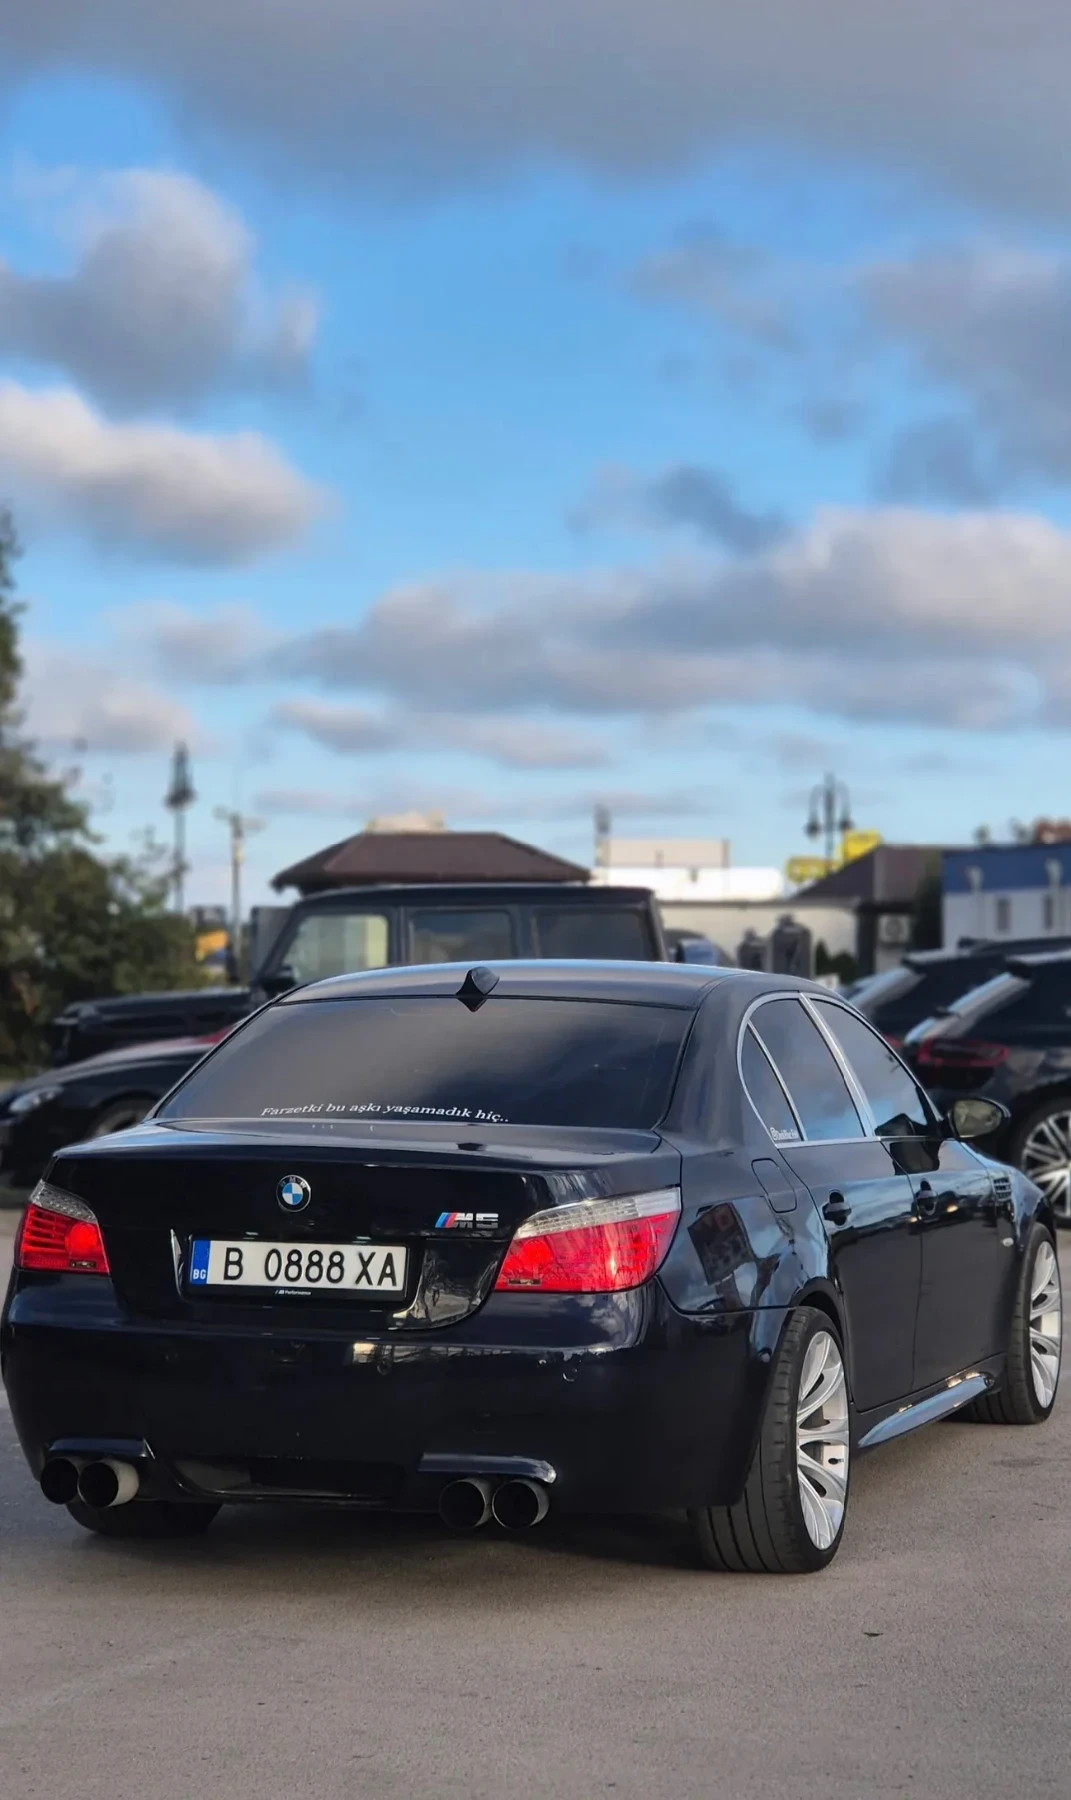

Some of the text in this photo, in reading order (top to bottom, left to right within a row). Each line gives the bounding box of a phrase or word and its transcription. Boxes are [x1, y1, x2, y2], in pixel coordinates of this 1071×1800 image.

[261, 1104, 324, 1116] Farzetki
[326, 1103, 346, 1112] bu
[349, 1103, 382, 1114] aşkı
[382, 1105, 472, 1118] yaşamadık
[450, 1212, 499, 1229] M5
[192, 1268, 207, 1280] BG
[223, 1247, 397, 1287] B 0888 XA
